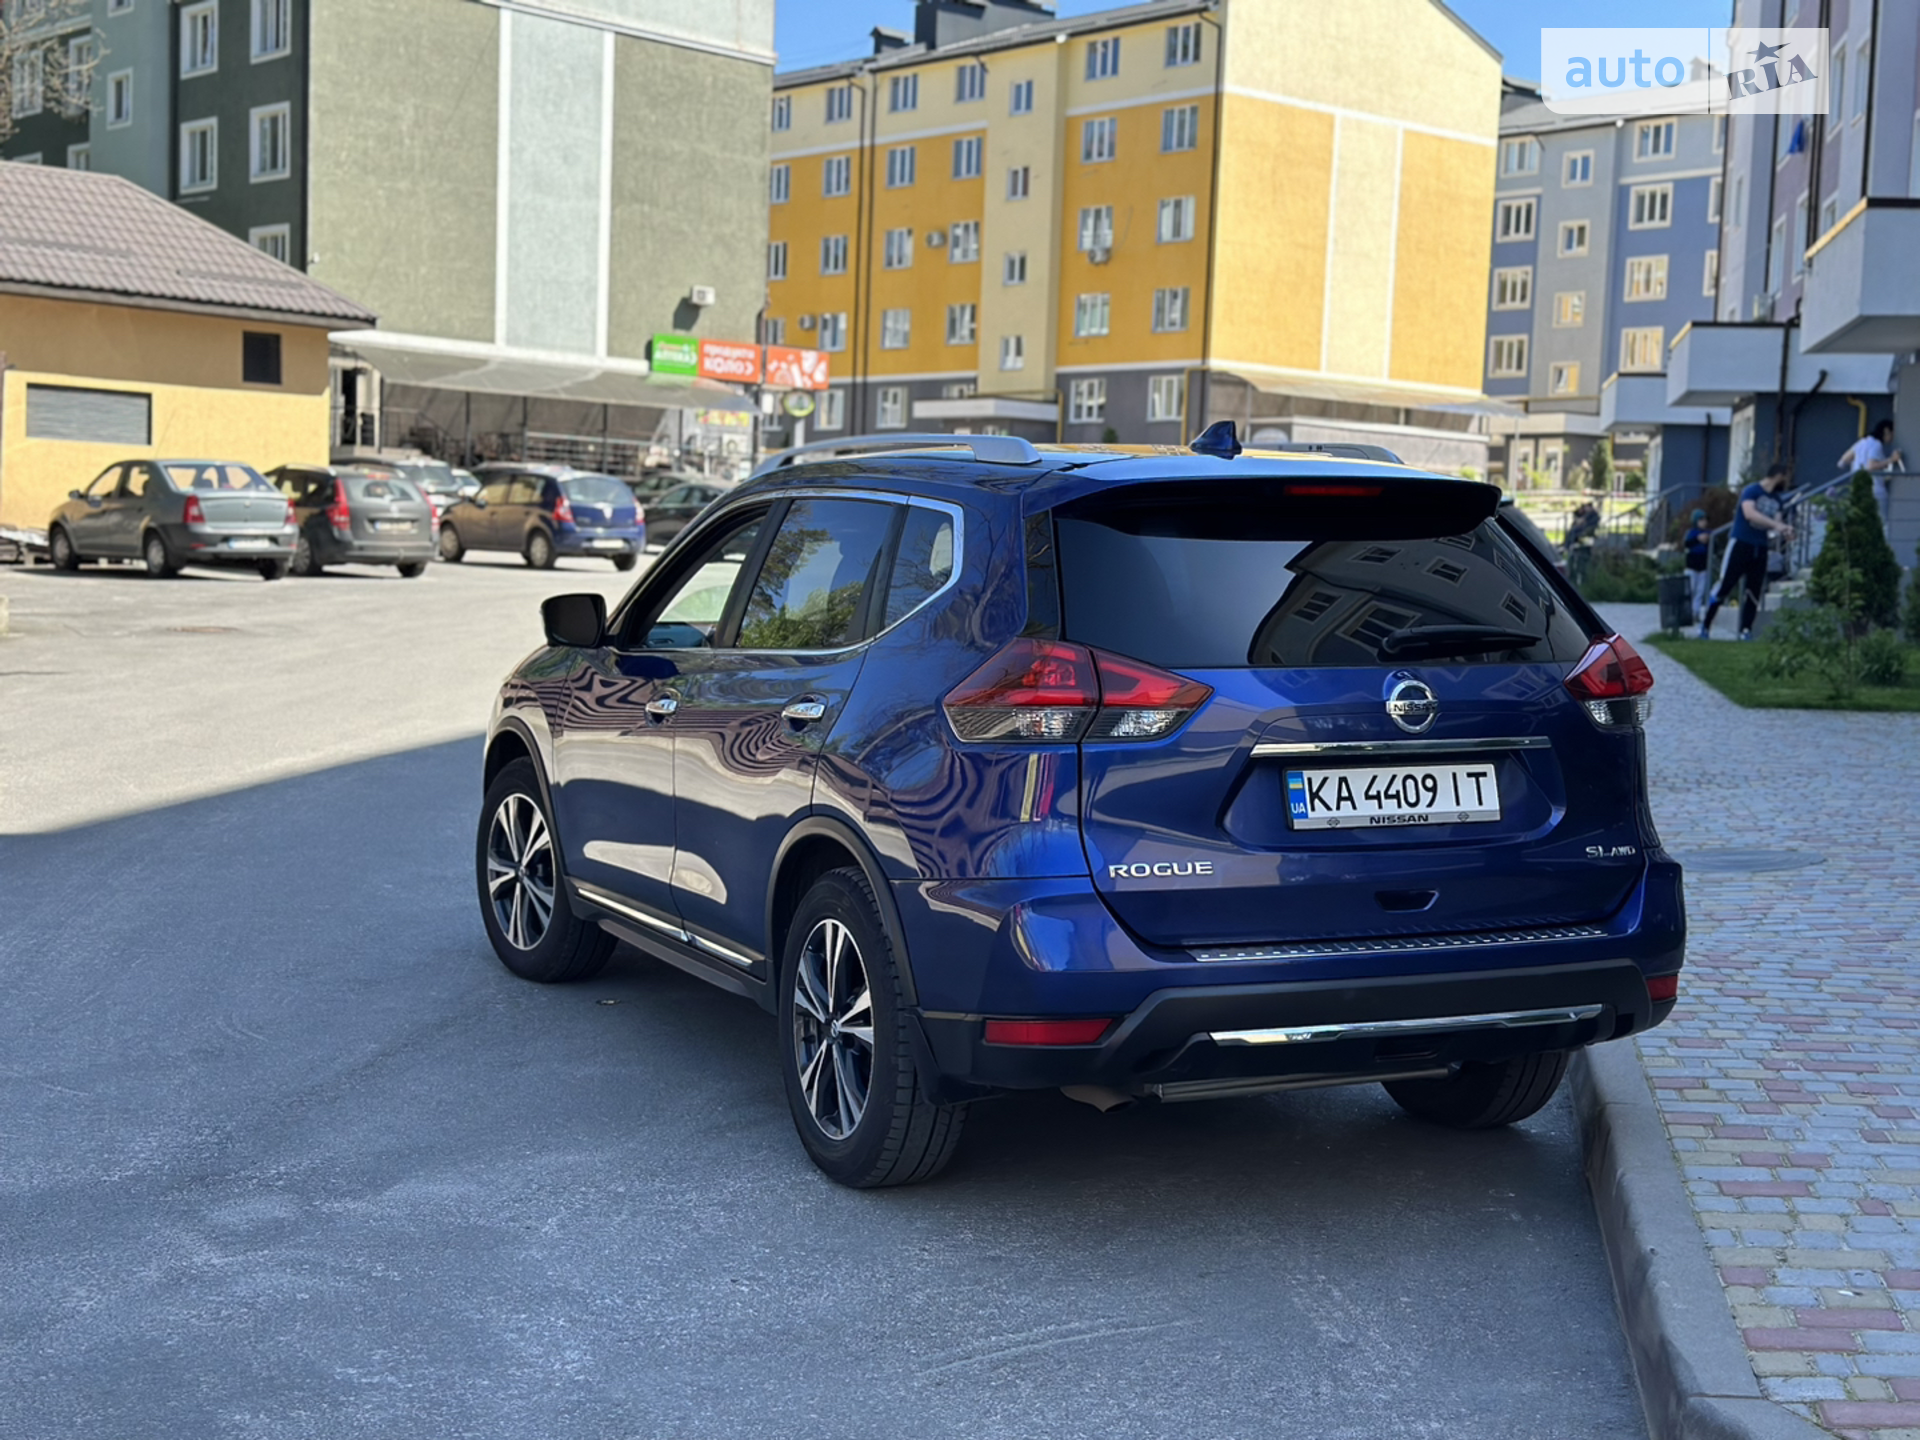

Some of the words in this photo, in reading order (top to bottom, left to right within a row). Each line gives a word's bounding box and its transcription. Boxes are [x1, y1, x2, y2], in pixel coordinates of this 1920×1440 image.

[1307, 776, 1357, 812] KA
[1364, 773, 1438, 810] 4409
[1452, 771, 1488, 806] IT
[1291, 802, 1306, 814] UA
[1369, 815, 1429, 825] NISSAN
[1611, 845, 1636, 857] AWD
[1108, 861, 1214, 878] ROGUE
